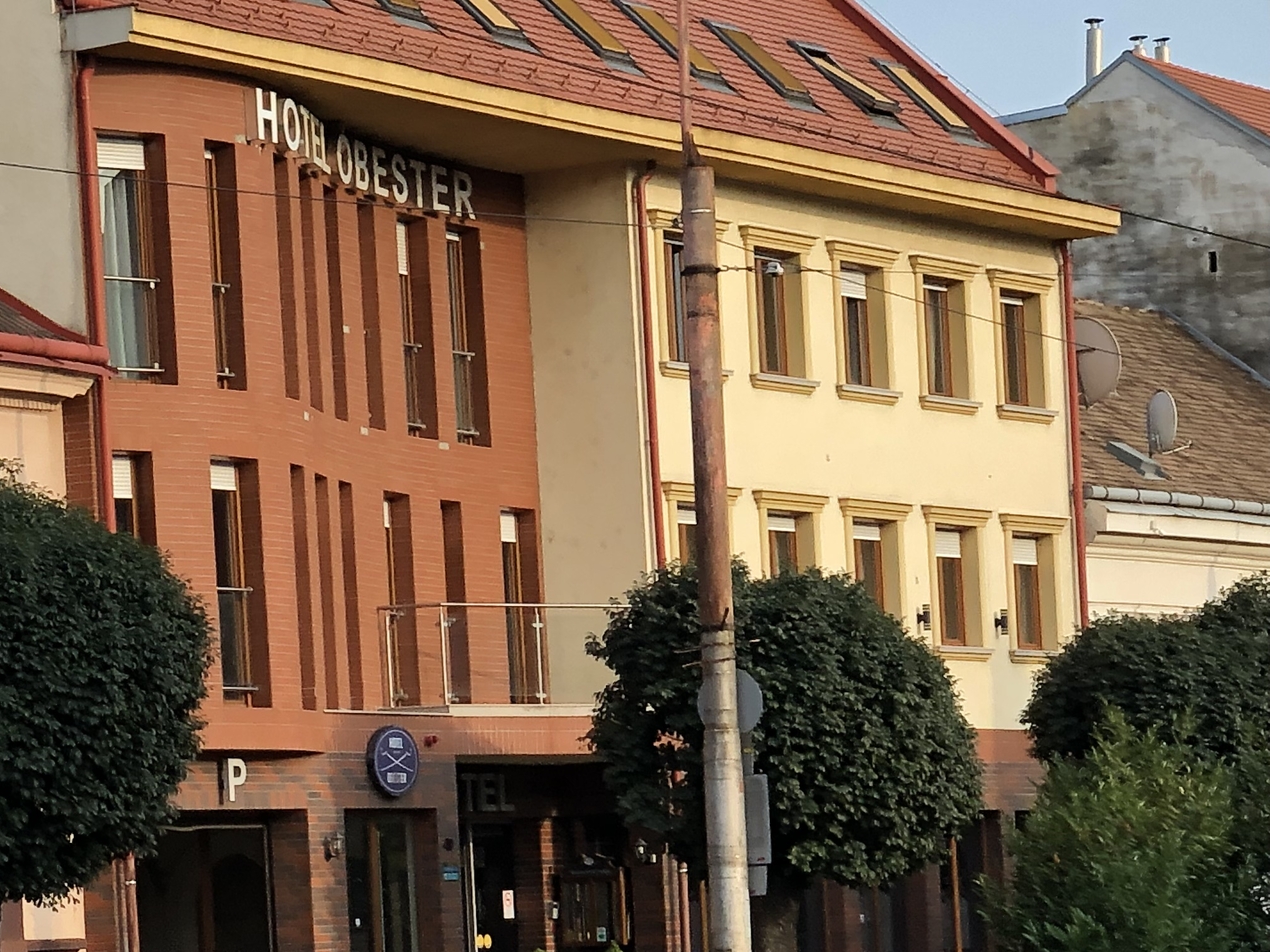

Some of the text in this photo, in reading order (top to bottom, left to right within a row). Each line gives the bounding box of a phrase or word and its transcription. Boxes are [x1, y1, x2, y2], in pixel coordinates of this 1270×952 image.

[255, 87, 477, 220] HOTEL OBESTER
[227, 757, 247, 802] P
